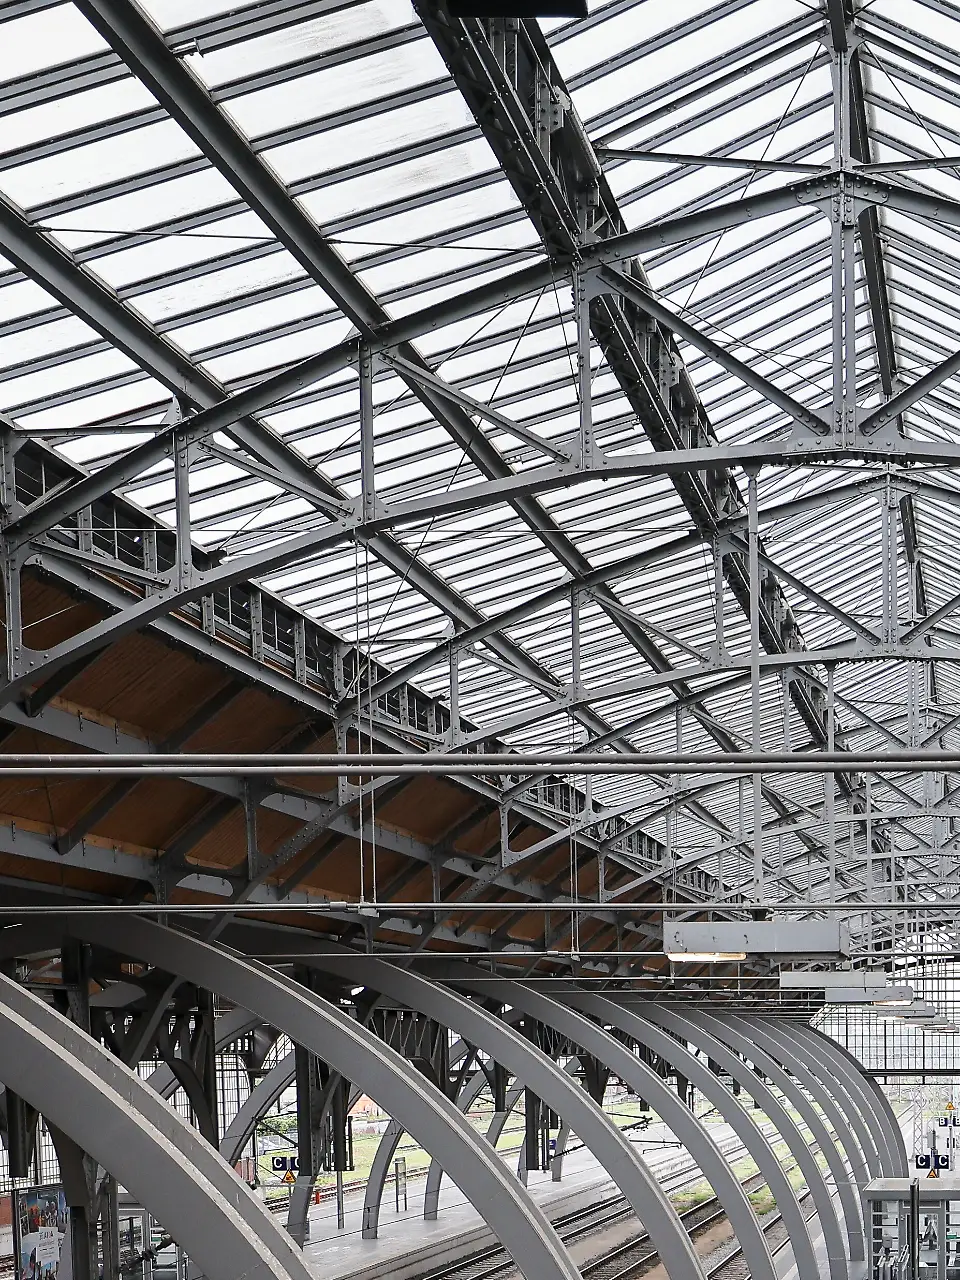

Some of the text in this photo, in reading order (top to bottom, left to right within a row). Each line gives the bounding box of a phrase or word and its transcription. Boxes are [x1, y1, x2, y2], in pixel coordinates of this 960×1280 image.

[274, 1157, 282, 1168] C
[917, 1156, 925, 1166] C
[939, 1156, 947, 1166] C
